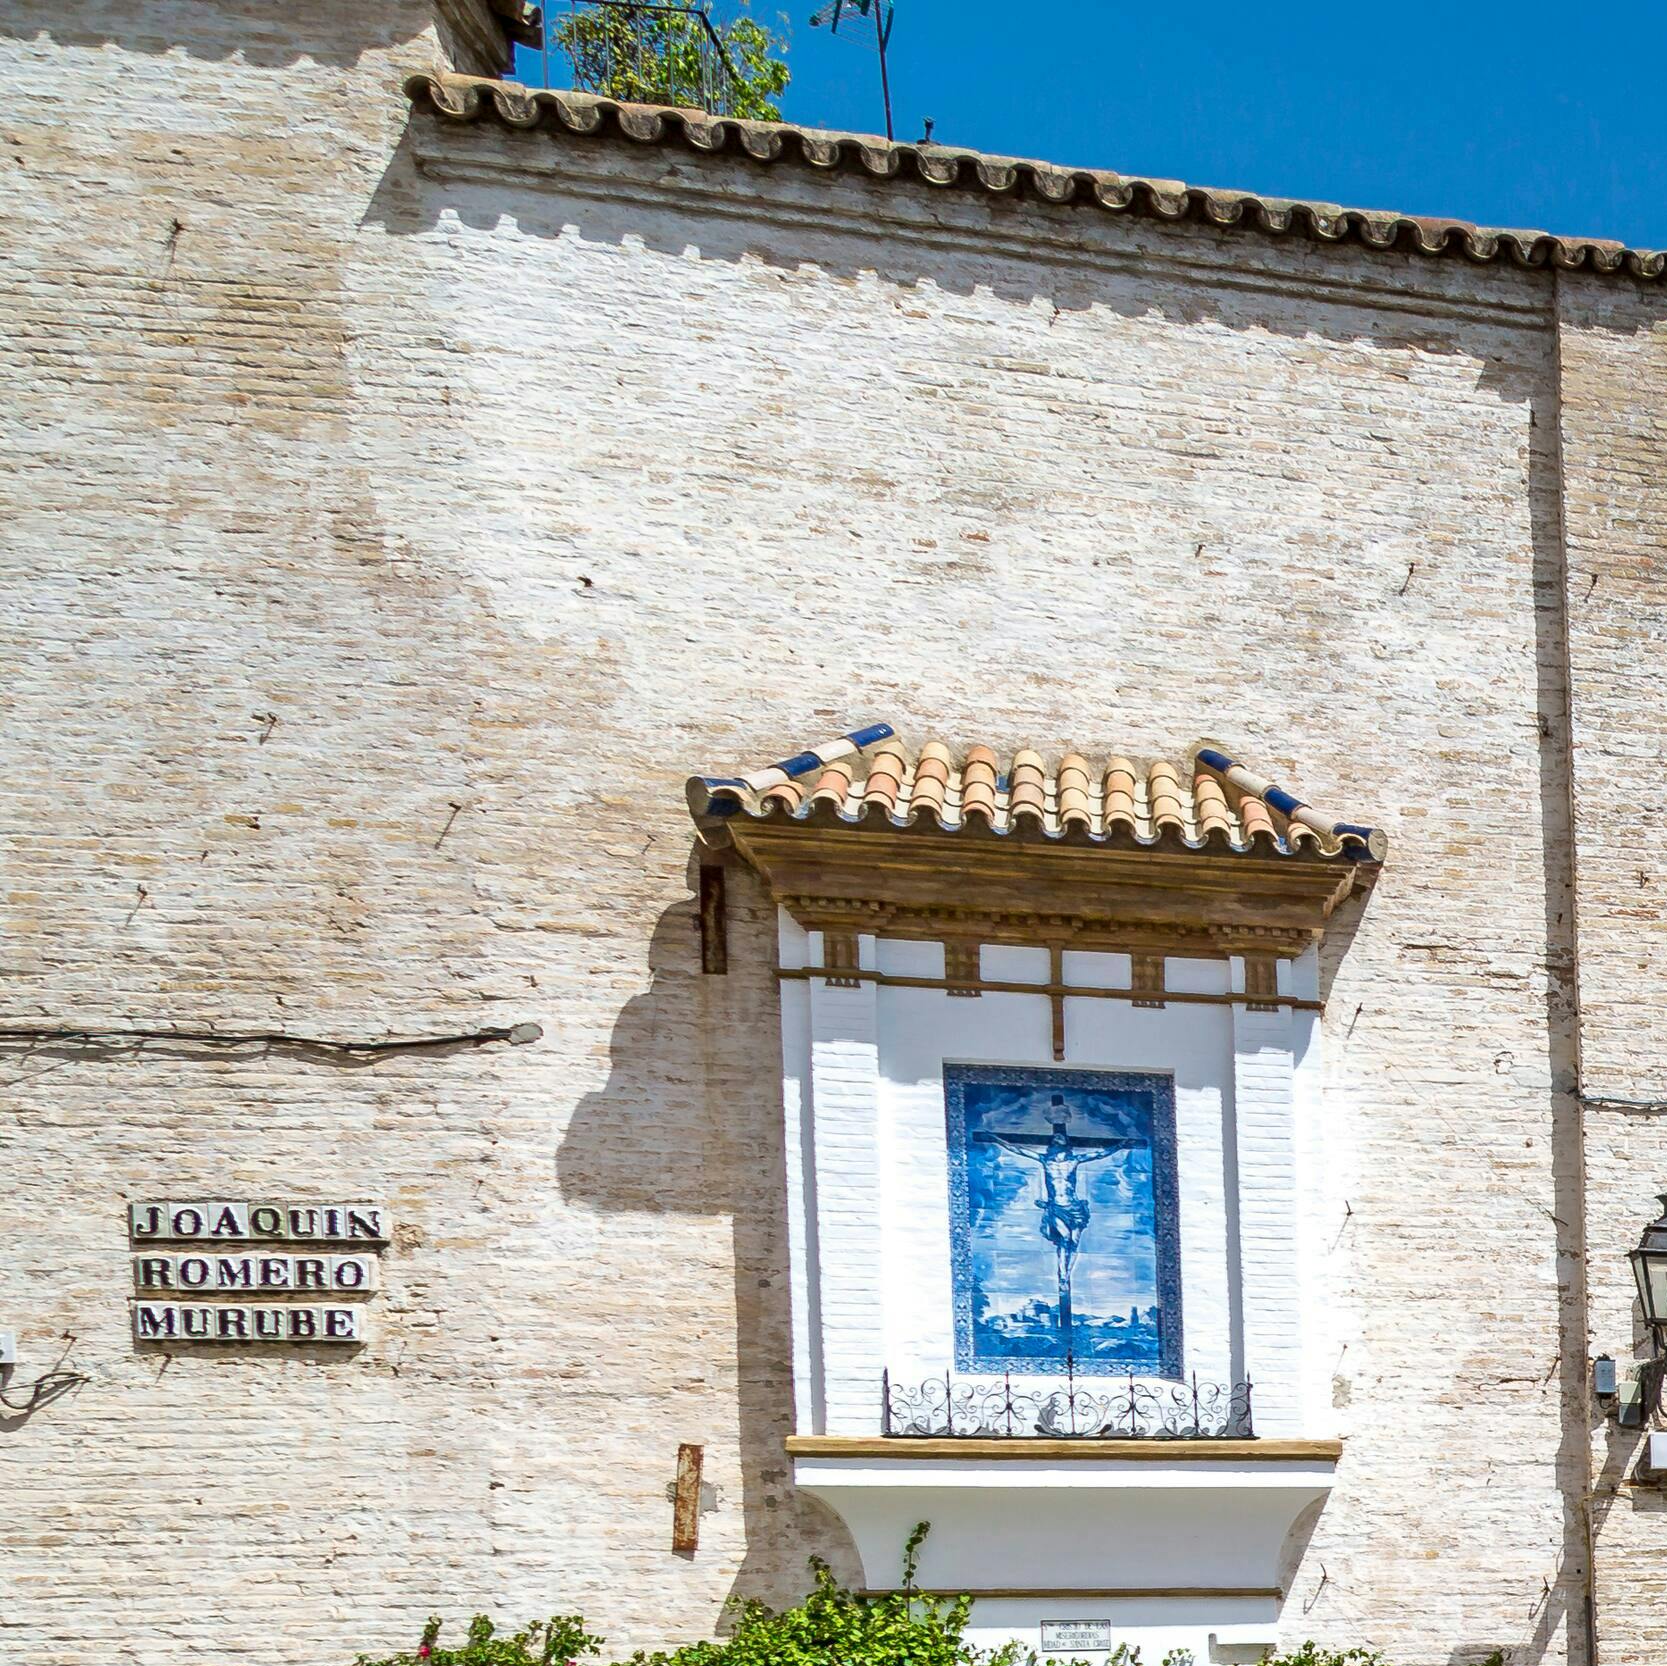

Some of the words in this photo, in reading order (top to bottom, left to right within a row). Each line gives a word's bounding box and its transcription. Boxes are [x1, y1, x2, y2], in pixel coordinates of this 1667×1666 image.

[136, 1206, 382, 1239] JOAQUIN
[140, 1257, 365, 1289] ROMERO
[139, 1306, 356, 1338] MURUBE
